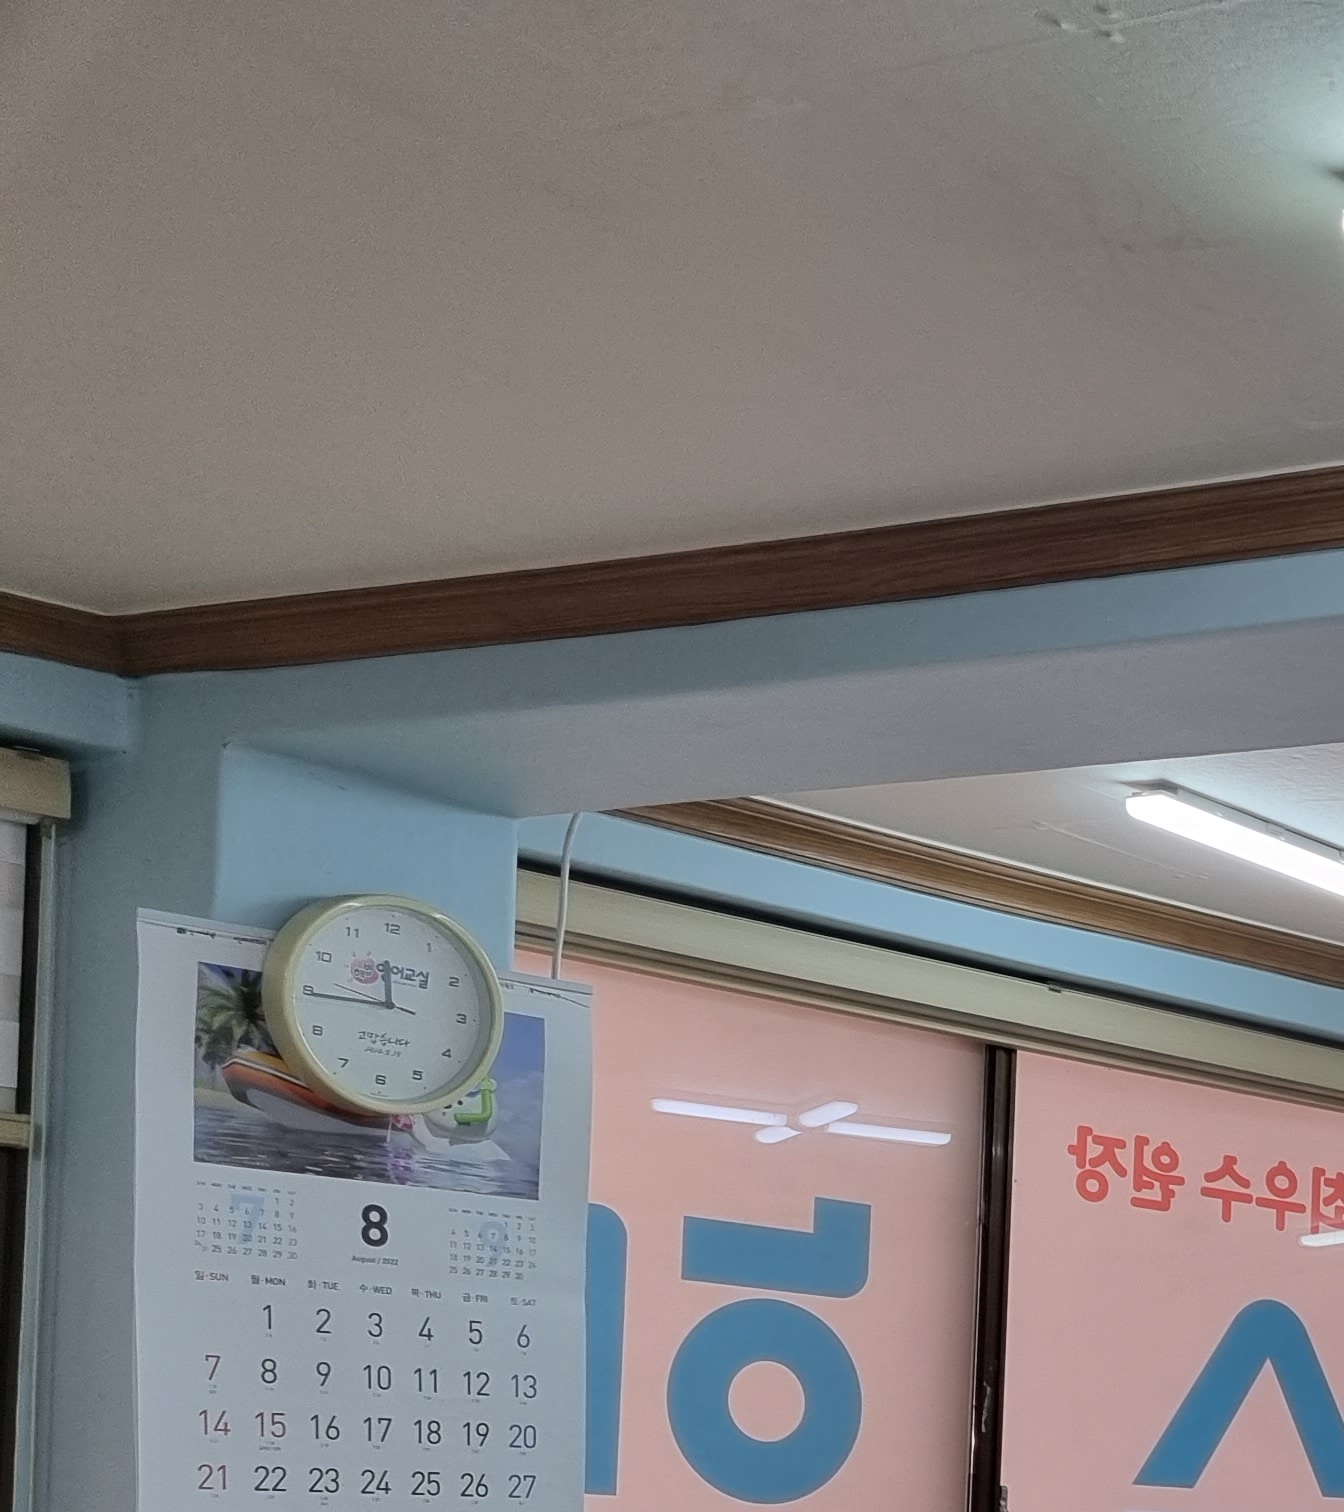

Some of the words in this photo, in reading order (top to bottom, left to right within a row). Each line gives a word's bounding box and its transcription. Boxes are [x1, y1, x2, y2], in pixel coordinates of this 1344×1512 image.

[345, 926, 360, 938] 11
[384, 922, 401, 935] 12
[426, 942, 432, 952] 1
[315, 951, 332, 963] 10
[448, 976, 460, 987] 2
[302, 985, 315, 996] 9
[456, 1013, 467, 1025] 3
[312, 1025, 323, 1036] 8
[441, 1048, 452, 1058] 4
[338, 1057, 349, 1068] 7
[375, 1074, 387, 1086] 6
[412, 1070, 424, 1081] 5
[361, 1203, 389, 1248] 8
[263, 1305, 271, 1329] 1
[316, 1309, 331, 1333] 2
[368, 1313, 382, 1337] 3
[419, 1317, 433, 1341] 4
[469, 1321, 482, 1344] 5
[517, 1325, 530, 1348] 6
[206, 1355, 220, 1380] 7
[261, 1359, 277, 1383] 8
[317, 1362, 330, 1386] 9
[364, 1365, 391, 1390] 10
[414, 1368, 437, 1393] 11
[463, 1372, 489, 1396] 12
[511, 1375, 536, 1398] 13
[199, 1410, 230, 1435] 14
[255, 1412, 285, 1437] 15
[311, 1415, 340, 1440] 16
[364, 1417, 392, 1442] 17
[414, 1420, 441, 1444] 18
[463, 1422, 489, 1446] 19
[509, 1425, 536, 1448] 20
[198, 1464, 226, 1490] 21
[254, 1466, 286, 1491] 22
[309, 1468, 339, 1493] 23
[361, 1470, 391, 1494] 24
[412, 1471, 440, 1496] 25
[461, 1473, 488, 1497] 26
[509, 1475, 536, 1498] 27
